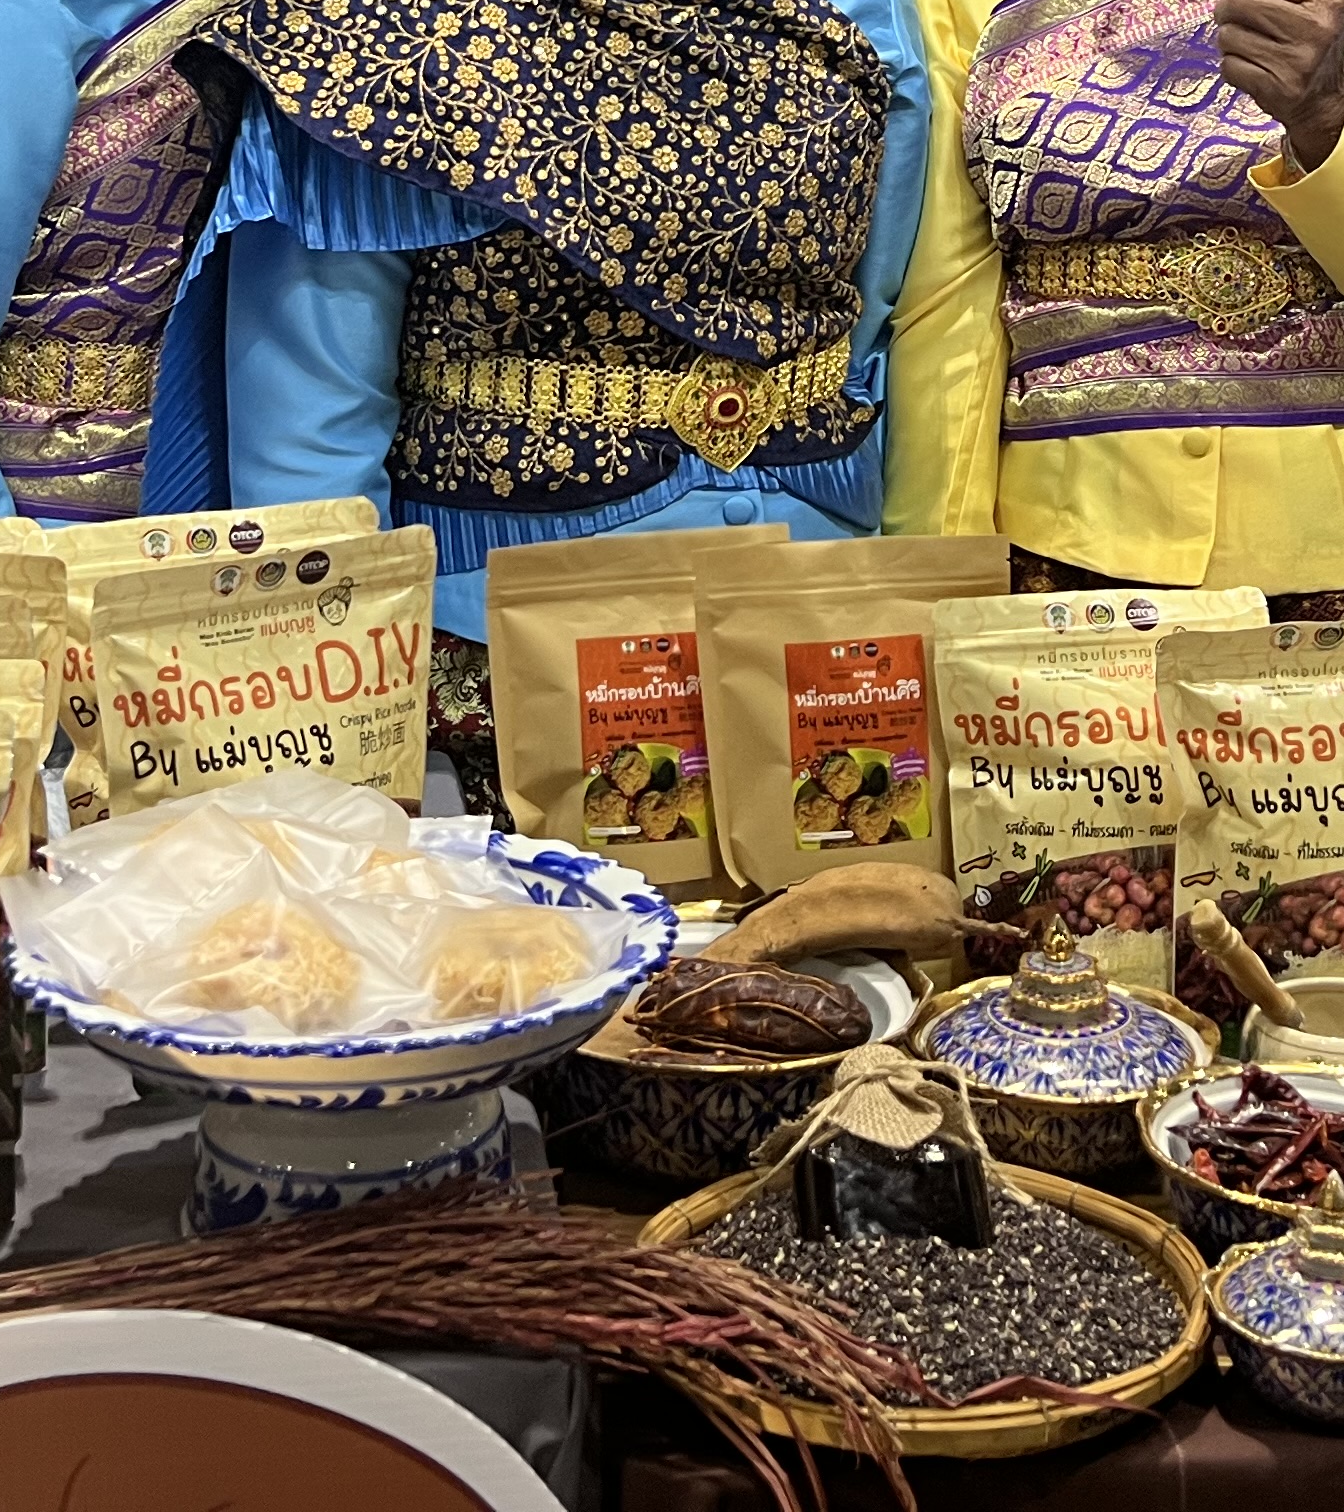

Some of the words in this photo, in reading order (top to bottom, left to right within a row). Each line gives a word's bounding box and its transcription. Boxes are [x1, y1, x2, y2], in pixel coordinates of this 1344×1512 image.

[954, 676, 1168, 749] หมี่กรอบ
[130, 739, 177, 786] By
[195, 722, 335, 774] แม่บุญชู
[970, 755, 1014, 799] By
[1030, 756, 1164, 805] แม่บุญชู
[1197, 770, 1242, 818] By
